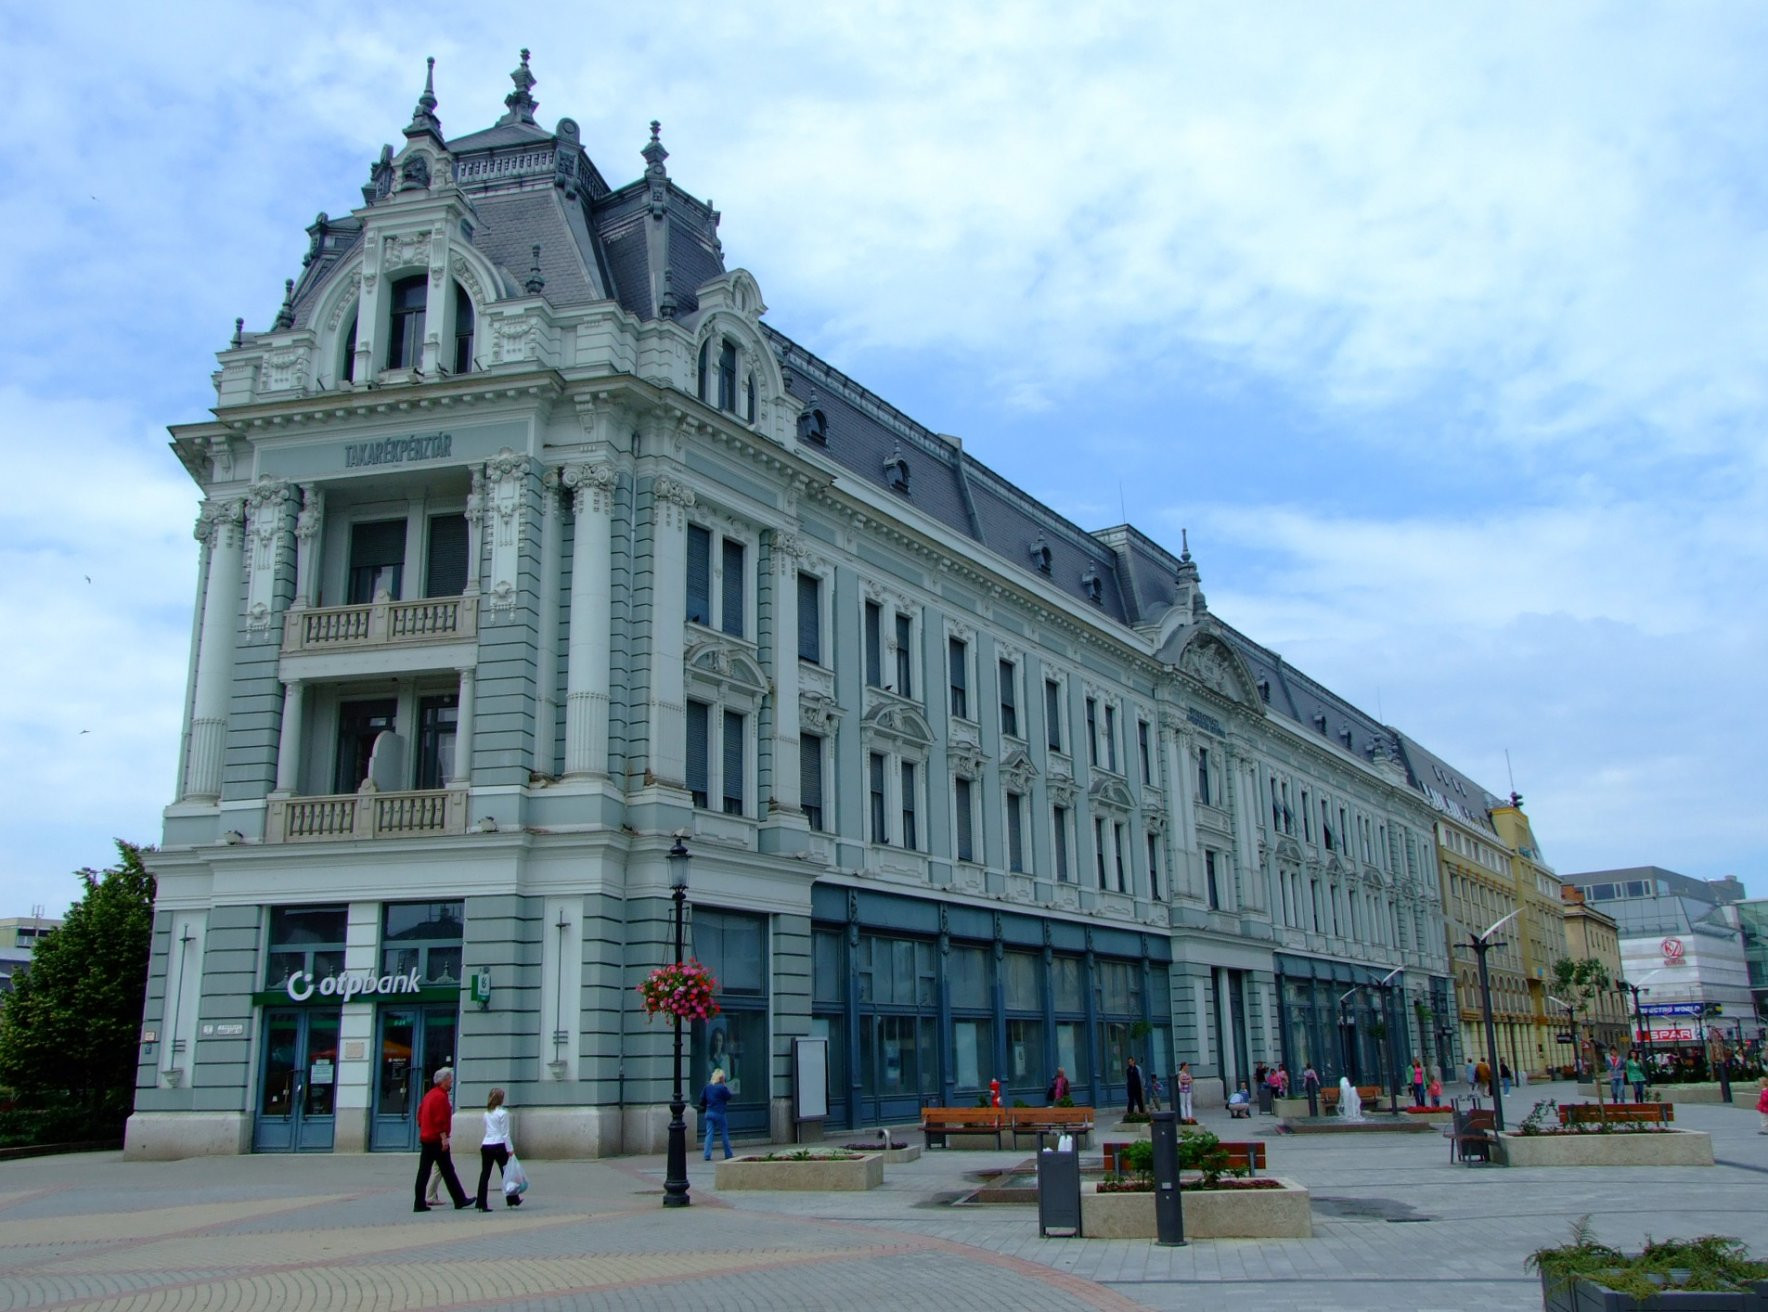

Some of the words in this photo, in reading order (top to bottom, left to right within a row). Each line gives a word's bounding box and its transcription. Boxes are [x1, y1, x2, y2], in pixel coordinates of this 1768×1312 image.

[345, 432, 452, 467] TAKARÉKPÉNZTÁR
[319, 967, 422, 1002] otpbank
[1651, 1031, 1691, 1039] SPAR
